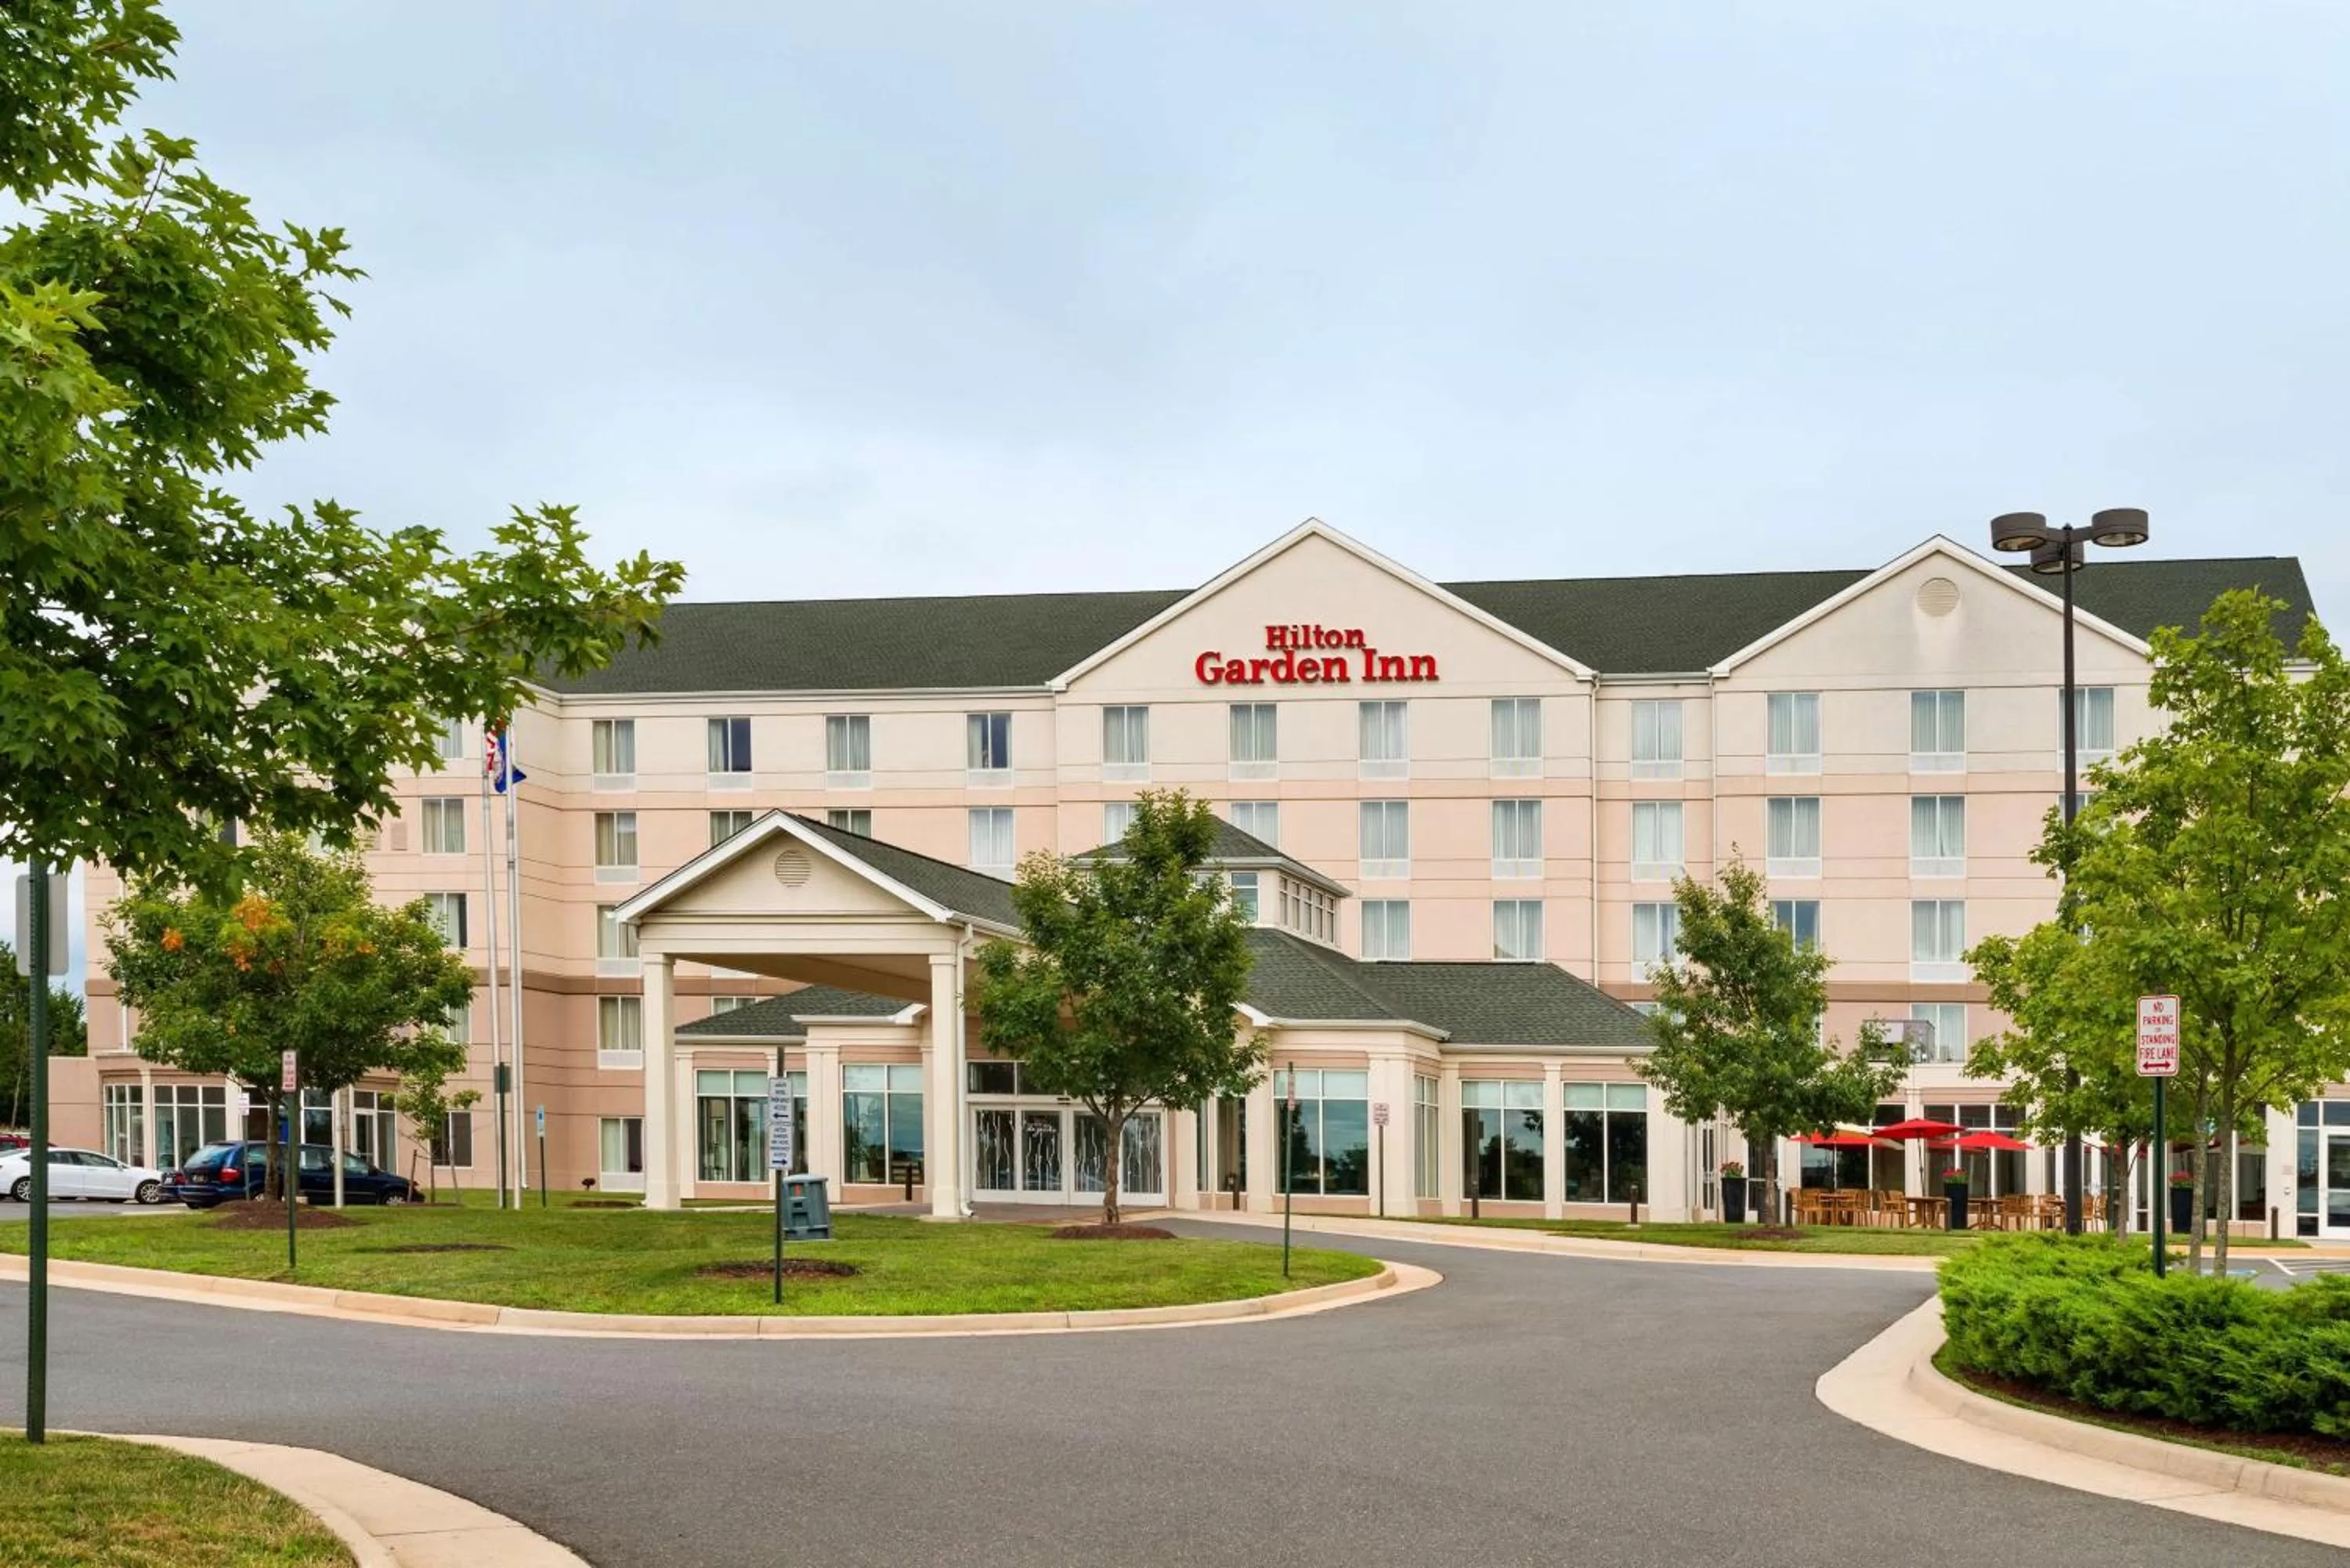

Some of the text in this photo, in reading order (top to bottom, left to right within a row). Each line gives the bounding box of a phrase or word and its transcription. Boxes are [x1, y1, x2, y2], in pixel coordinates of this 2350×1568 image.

[1265, 624, 1366, 651] Hilton
[1195, 648, 1440, 685] Garden Inn
[2153, 1002, 2164, 1013] NO
[2142, 1015, 2174, 1025] PARKING
[2141, 1035, 2175, 1045] STANDING
[2140, 1047, 2176, 1060] FIRE LANE
